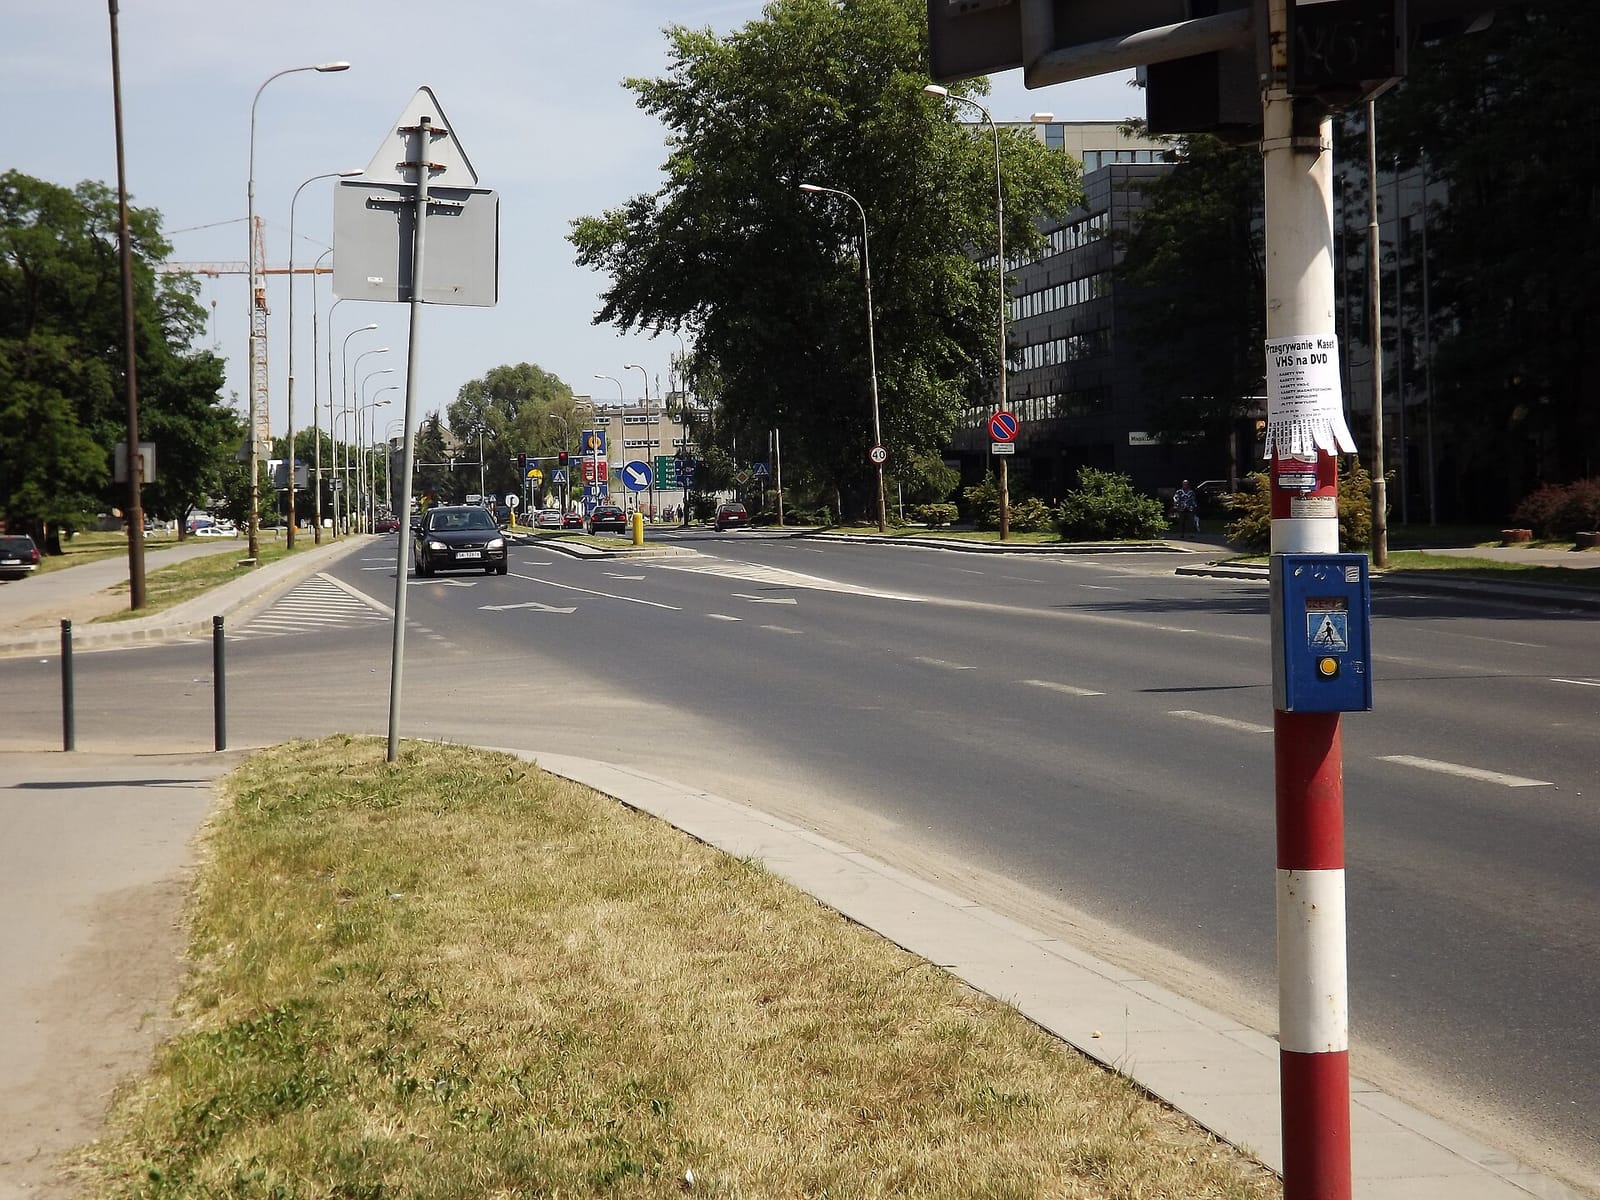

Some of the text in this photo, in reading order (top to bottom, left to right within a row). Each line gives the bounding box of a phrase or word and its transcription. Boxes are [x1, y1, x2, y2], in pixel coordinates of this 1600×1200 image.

[1265, 339, 1335, 355] Przegrywanie Kaset
[1275, 353, 1328, 367] VHS na DVD
[872, 450, 886, 460] 40
